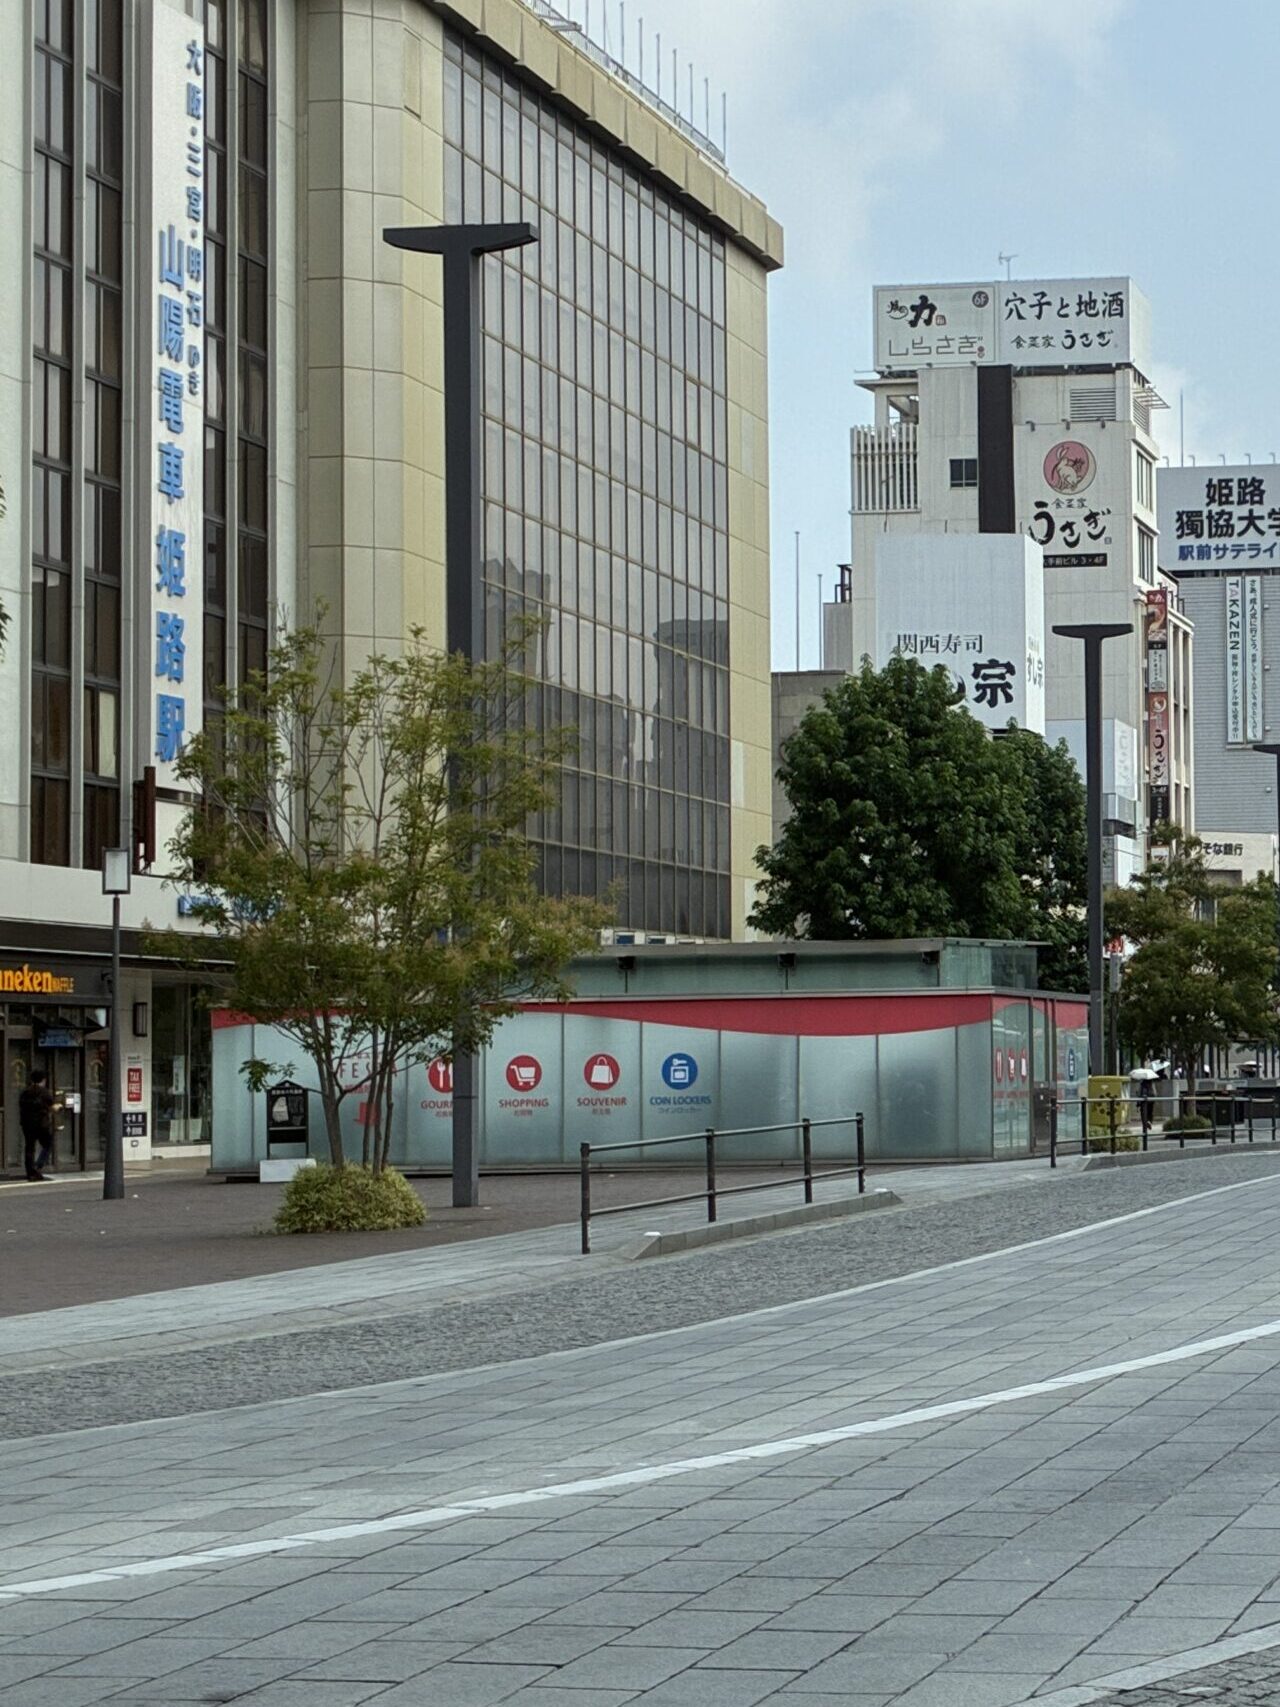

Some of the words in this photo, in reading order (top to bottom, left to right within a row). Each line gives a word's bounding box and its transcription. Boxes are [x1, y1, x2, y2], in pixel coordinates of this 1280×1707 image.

[1004, 290, 1125, 321] 穴子と地酒
[889, 335, 983, 357] しらさぎ
[1061, 329, 1114, 350] うさぎ
[155, 223, 186, 763] 山陽電車姫路駅
[1205, 477, 1265, 507] 姫路
[1028, 500, 1112, 549] うさぎ
[1229, 580, 1240, 650] TAKAZEN
[897, 633, 984, 654] 関西寿司
[421, 1100, 453, 1110] GOUR
[498, 1098, 550, 1108] SHOPPING
[576, 1097, 628, 1107] SOUVENIR
